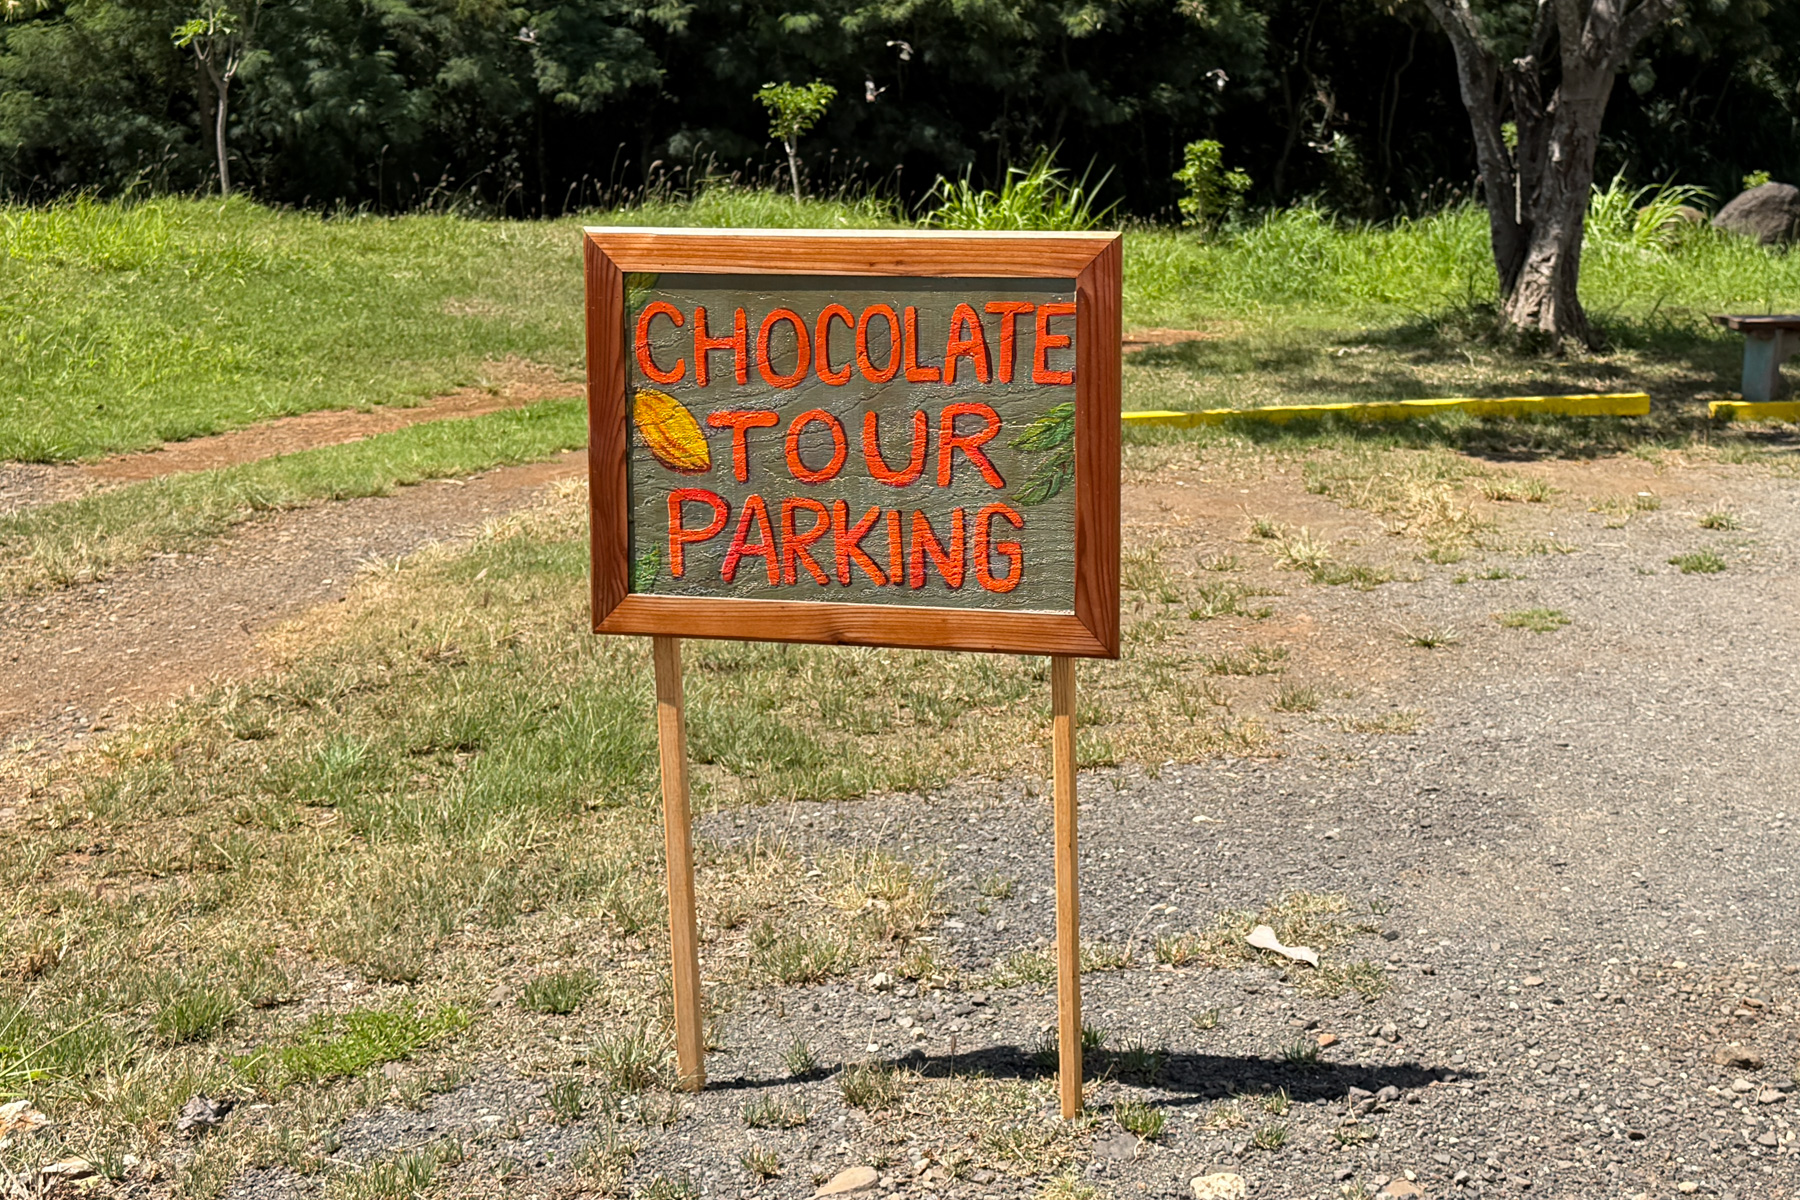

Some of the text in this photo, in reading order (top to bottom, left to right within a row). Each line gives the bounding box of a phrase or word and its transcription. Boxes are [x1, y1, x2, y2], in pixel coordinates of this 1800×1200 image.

[634, 300, 1075, 390] CHOCOLATE
[706, 401, 1004, 489] TOUR
[667, 487, 1024, 593] PARKING
